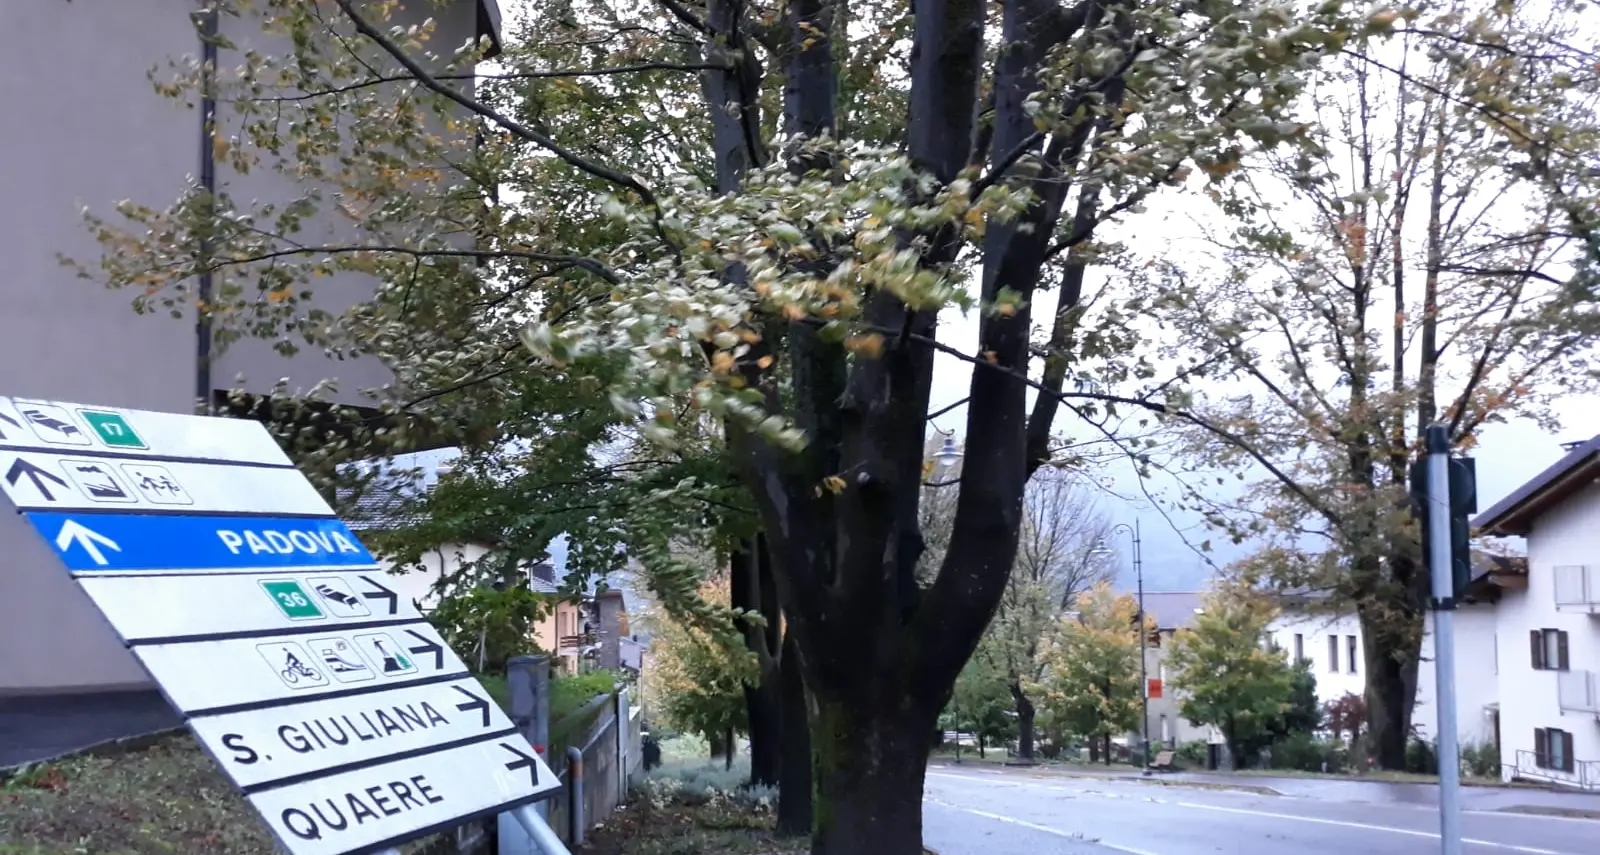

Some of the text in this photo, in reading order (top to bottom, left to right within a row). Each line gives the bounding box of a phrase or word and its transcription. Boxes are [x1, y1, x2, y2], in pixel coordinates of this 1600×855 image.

[101, 422, 124, 436] 17
[216, 530, 360, 554] PADOVA
[277, 592, 308, 608] 36
[221, 701, 450, 765] S. GIULIANA
[281, 775, 444, 841] QUAERE
